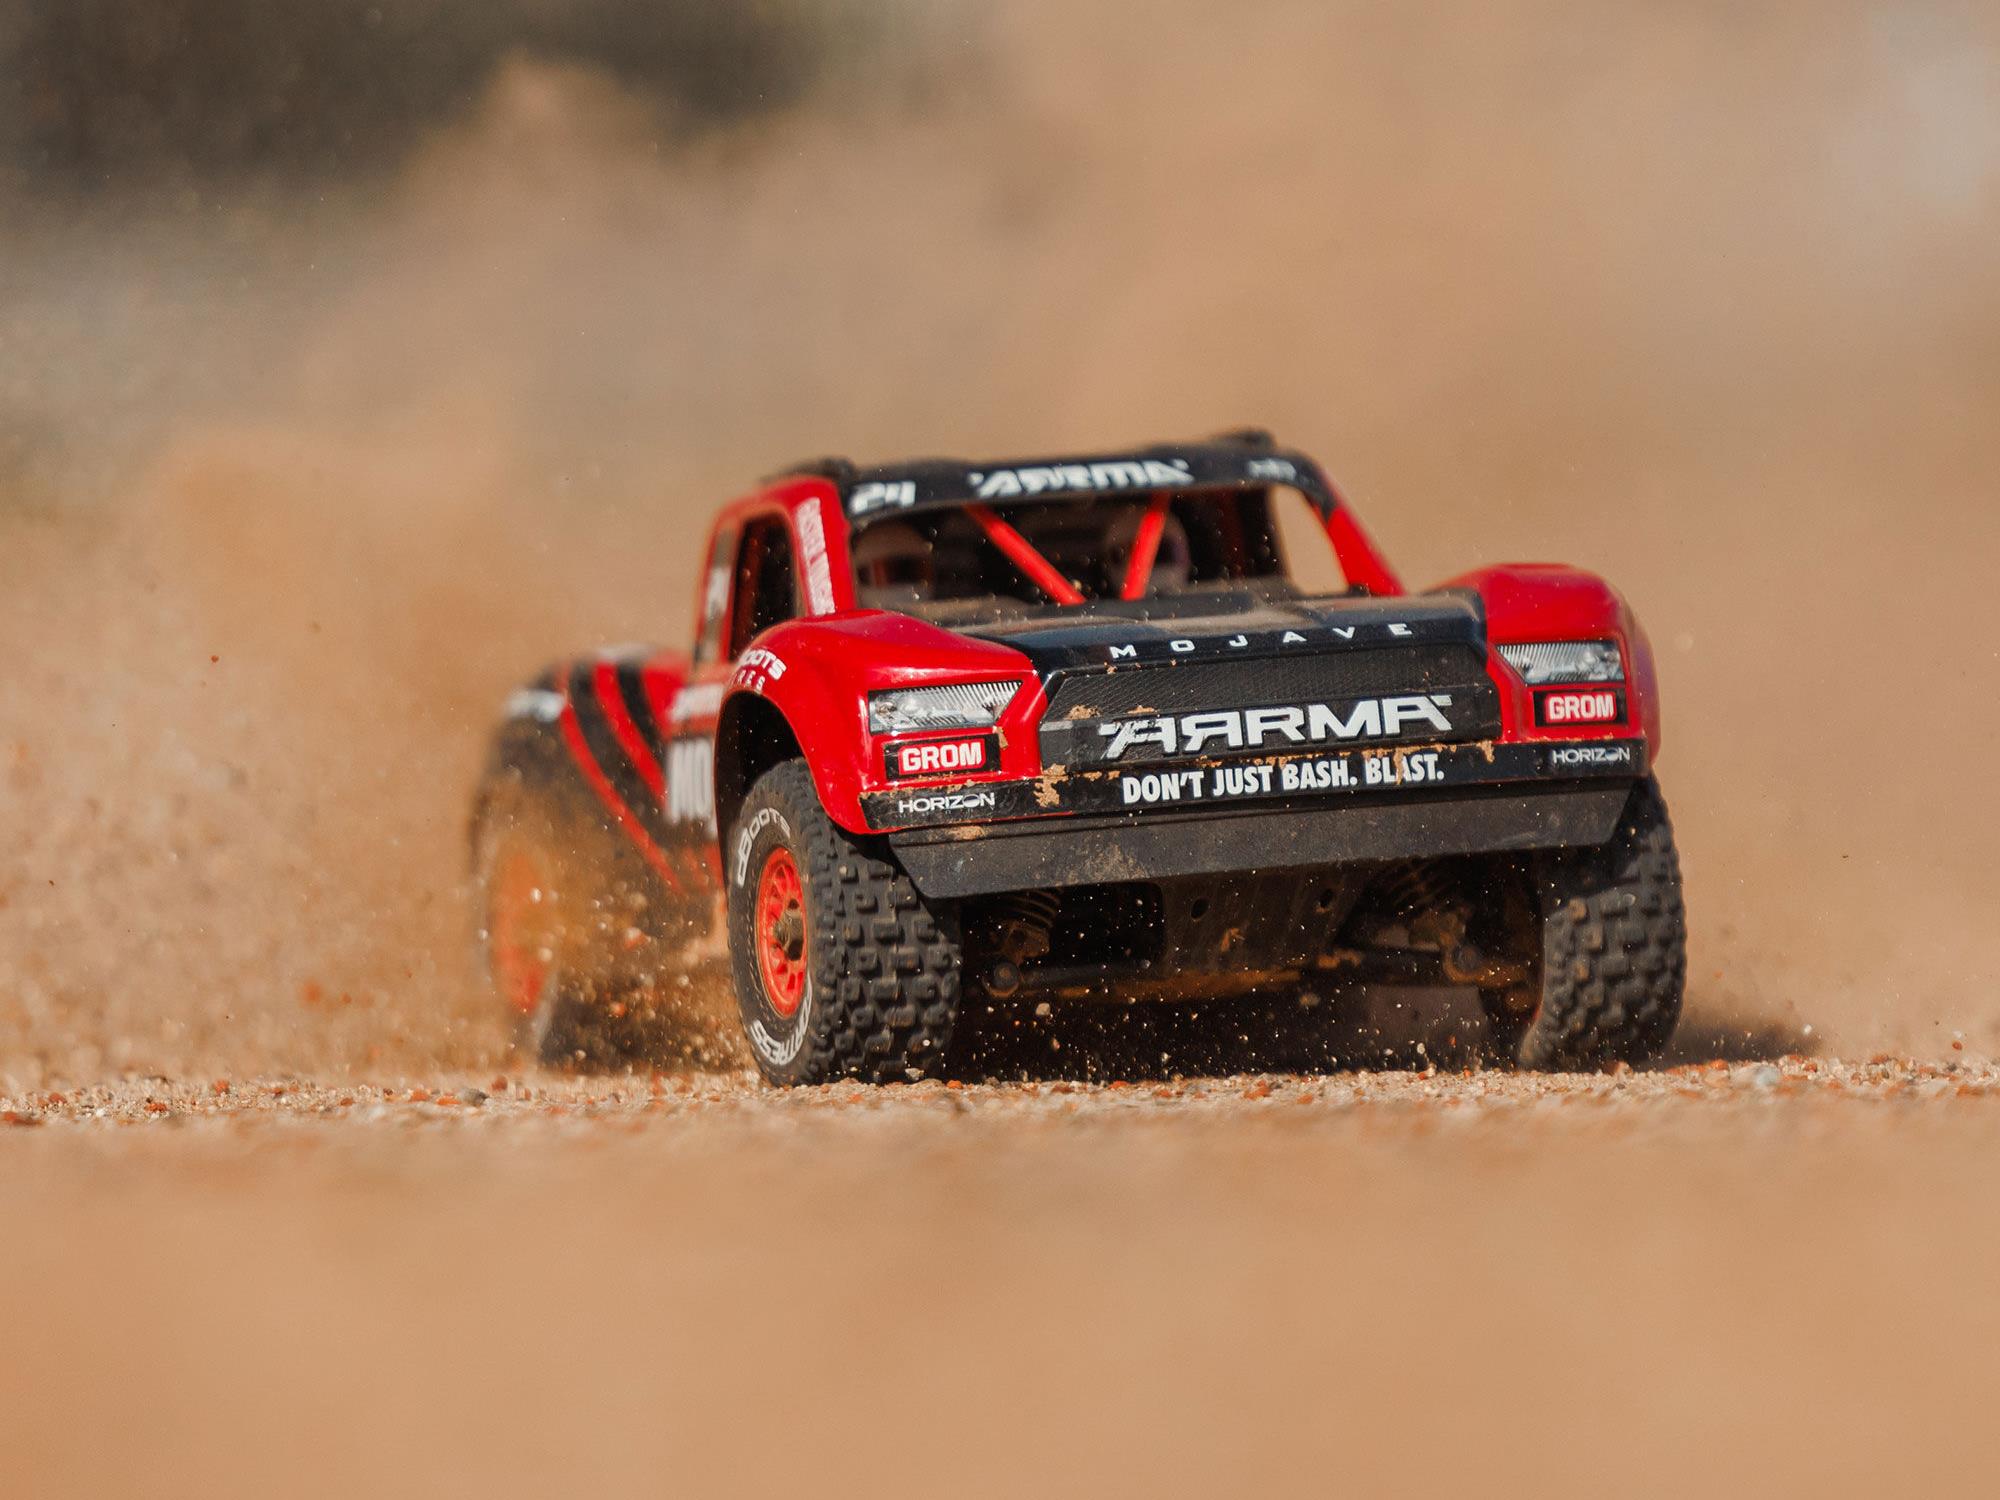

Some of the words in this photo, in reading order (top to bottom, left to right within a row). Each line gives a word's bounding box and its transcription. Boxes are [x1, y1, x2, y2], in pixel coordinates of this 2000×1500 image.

[1109, 622, 1415, 659] MOJAVE
[1548, 693, 1614, 721] GROM
[1099, 695, 1453, 760] ARRMA
[901, 741, 984, 773] GROM
[1552, 747, 1631, 769] HORIZON
[1122, 770, 1204, 805] DON'T
[1212, 765, 1274, 799] JUST
[1281, 760, 1358, 792] BASH.
[1364, 753, 1445, 787] BLAST.
[898, 792, 996, 814] HORIZON
